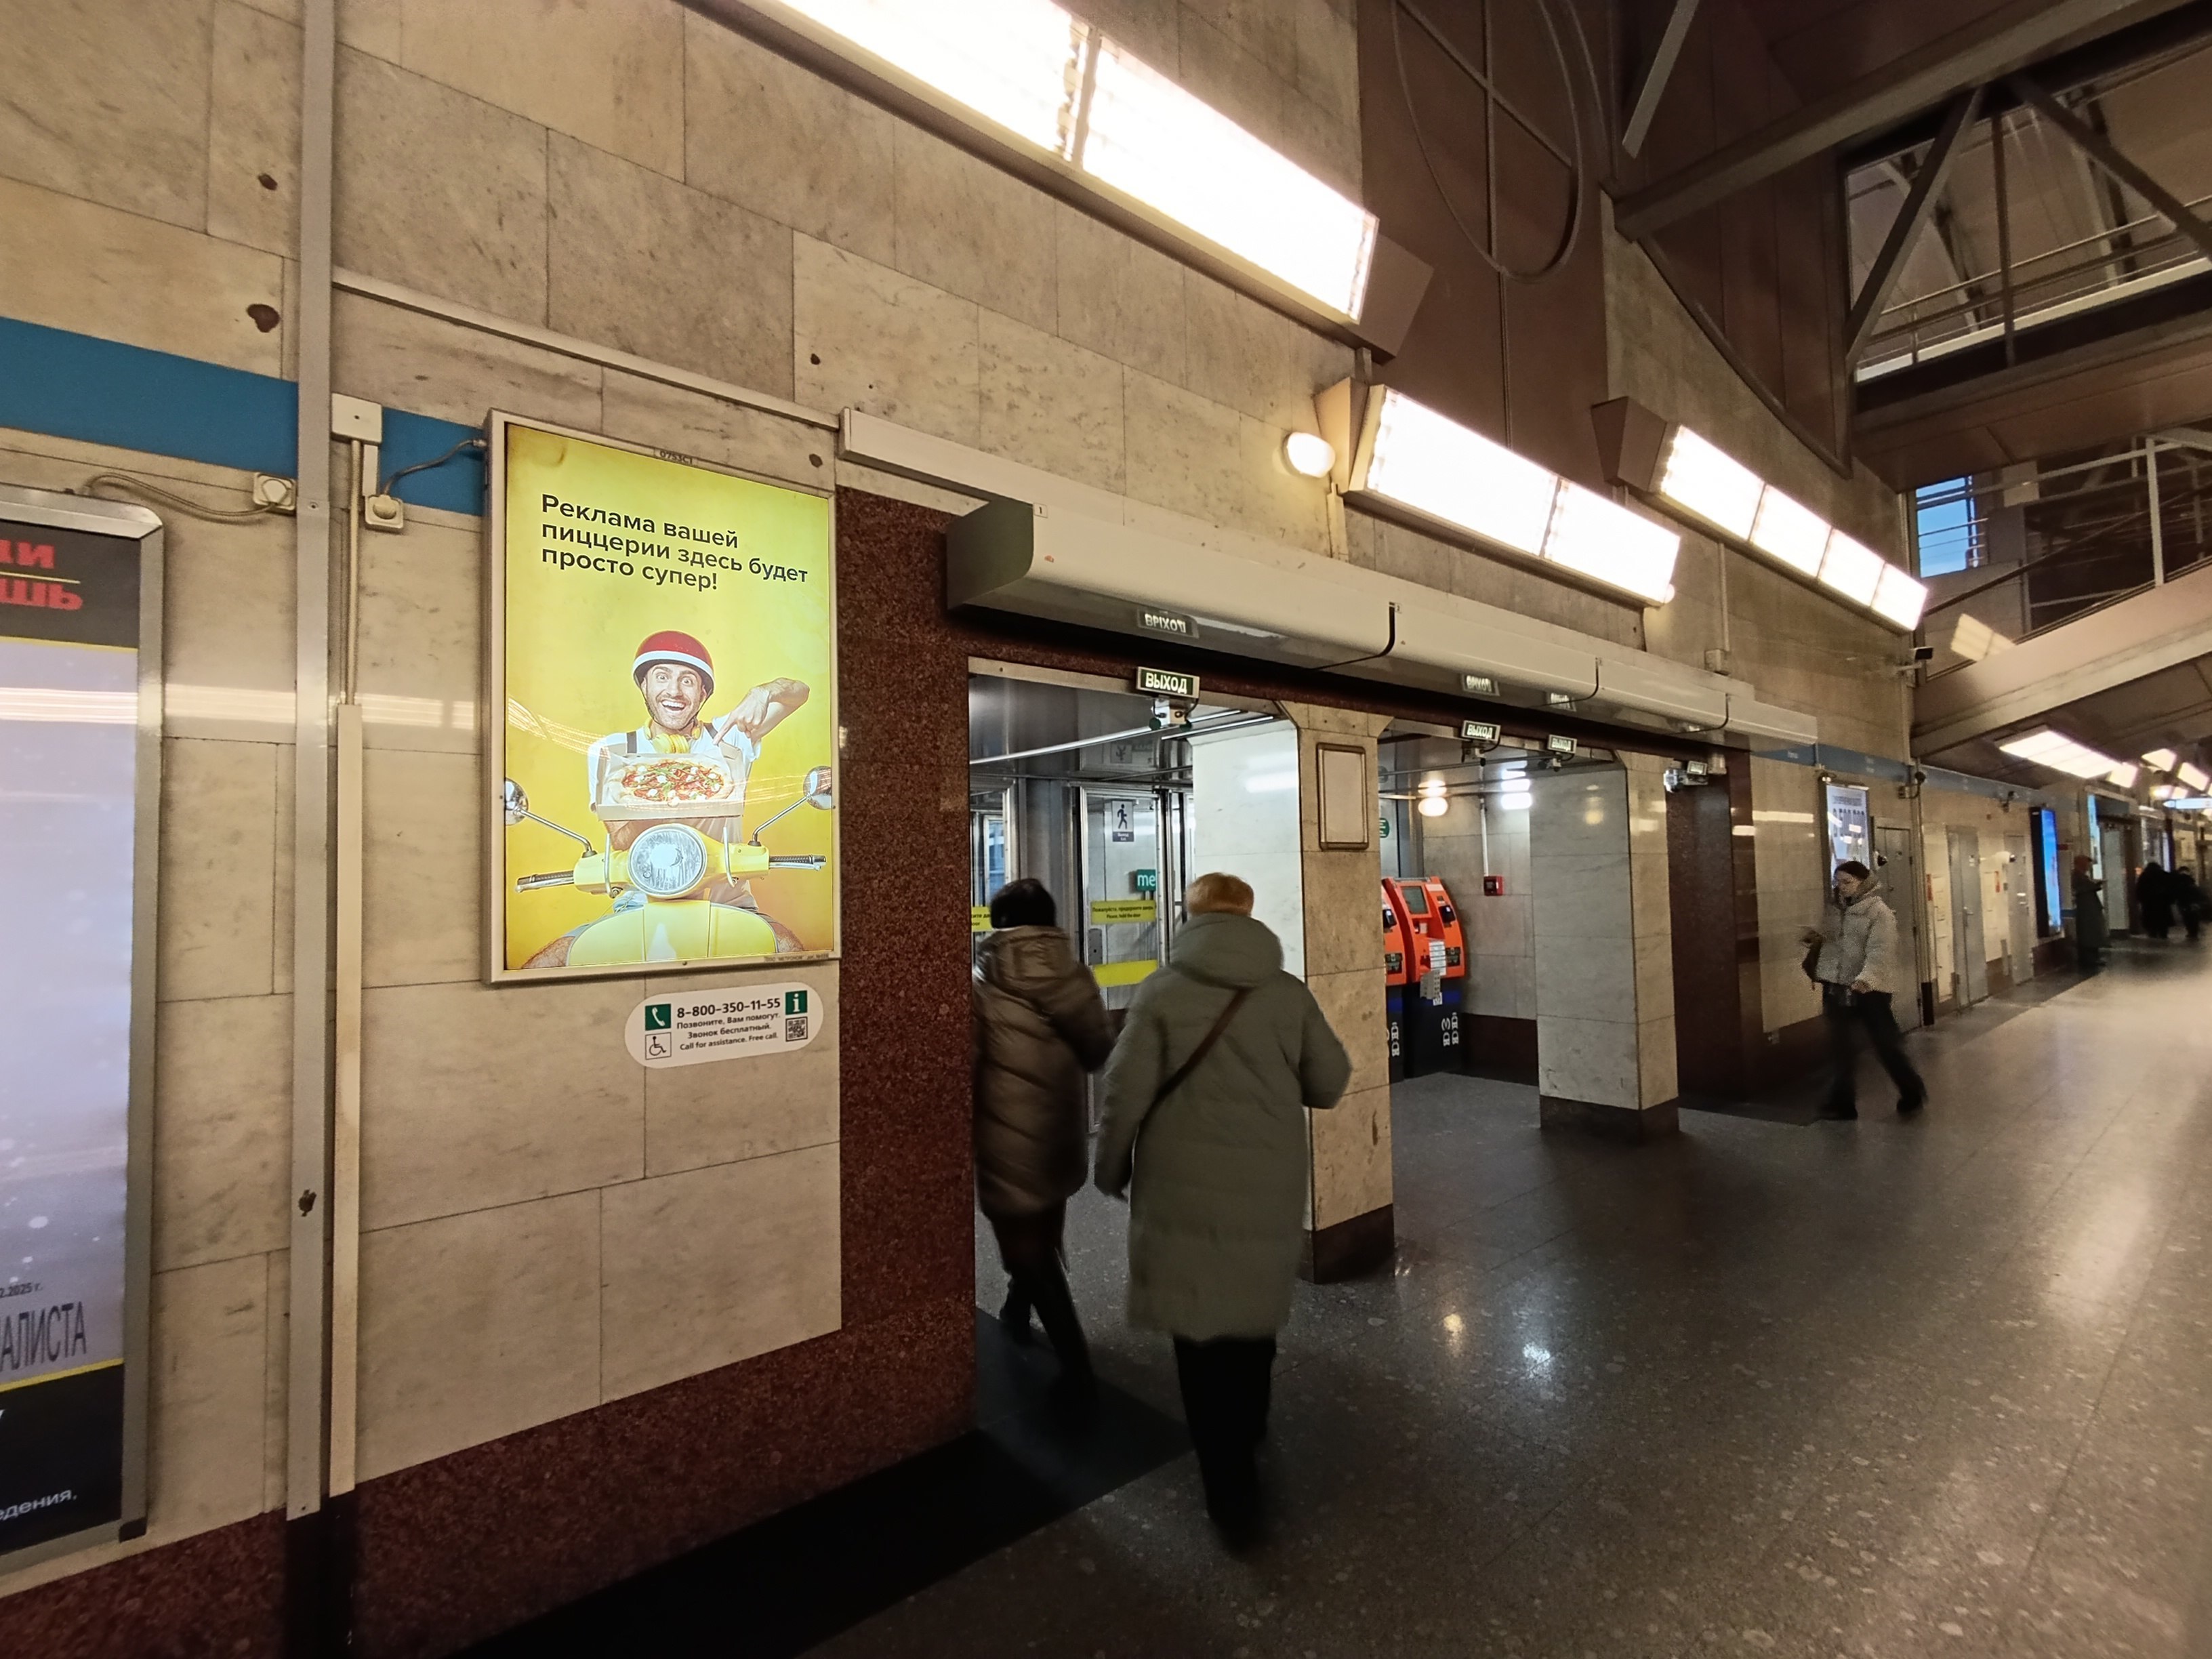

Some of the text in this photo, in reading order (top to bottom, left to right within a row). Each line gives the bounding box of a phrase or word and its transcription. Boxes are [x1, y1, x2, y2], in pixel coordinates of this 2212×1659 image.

[541, 493, 739, 549] Реклама вашей
[541, 523, 808, 583] пиццерии здесь будет
[541, 548, 718, 592] просто супер!
[1145, 672, 1187, 695] ВЫХОД
[1467, 724, 1493, 739] ВЫХОД
[1551, 738, 1572, 752] ВЫХОД
[676, 998, 781, 1018] 8-800-350-11-55
[687, 1023, 772, 1040] Звонок бесплатный.
[0, 1301, 87, 1372] АЛИСТА
